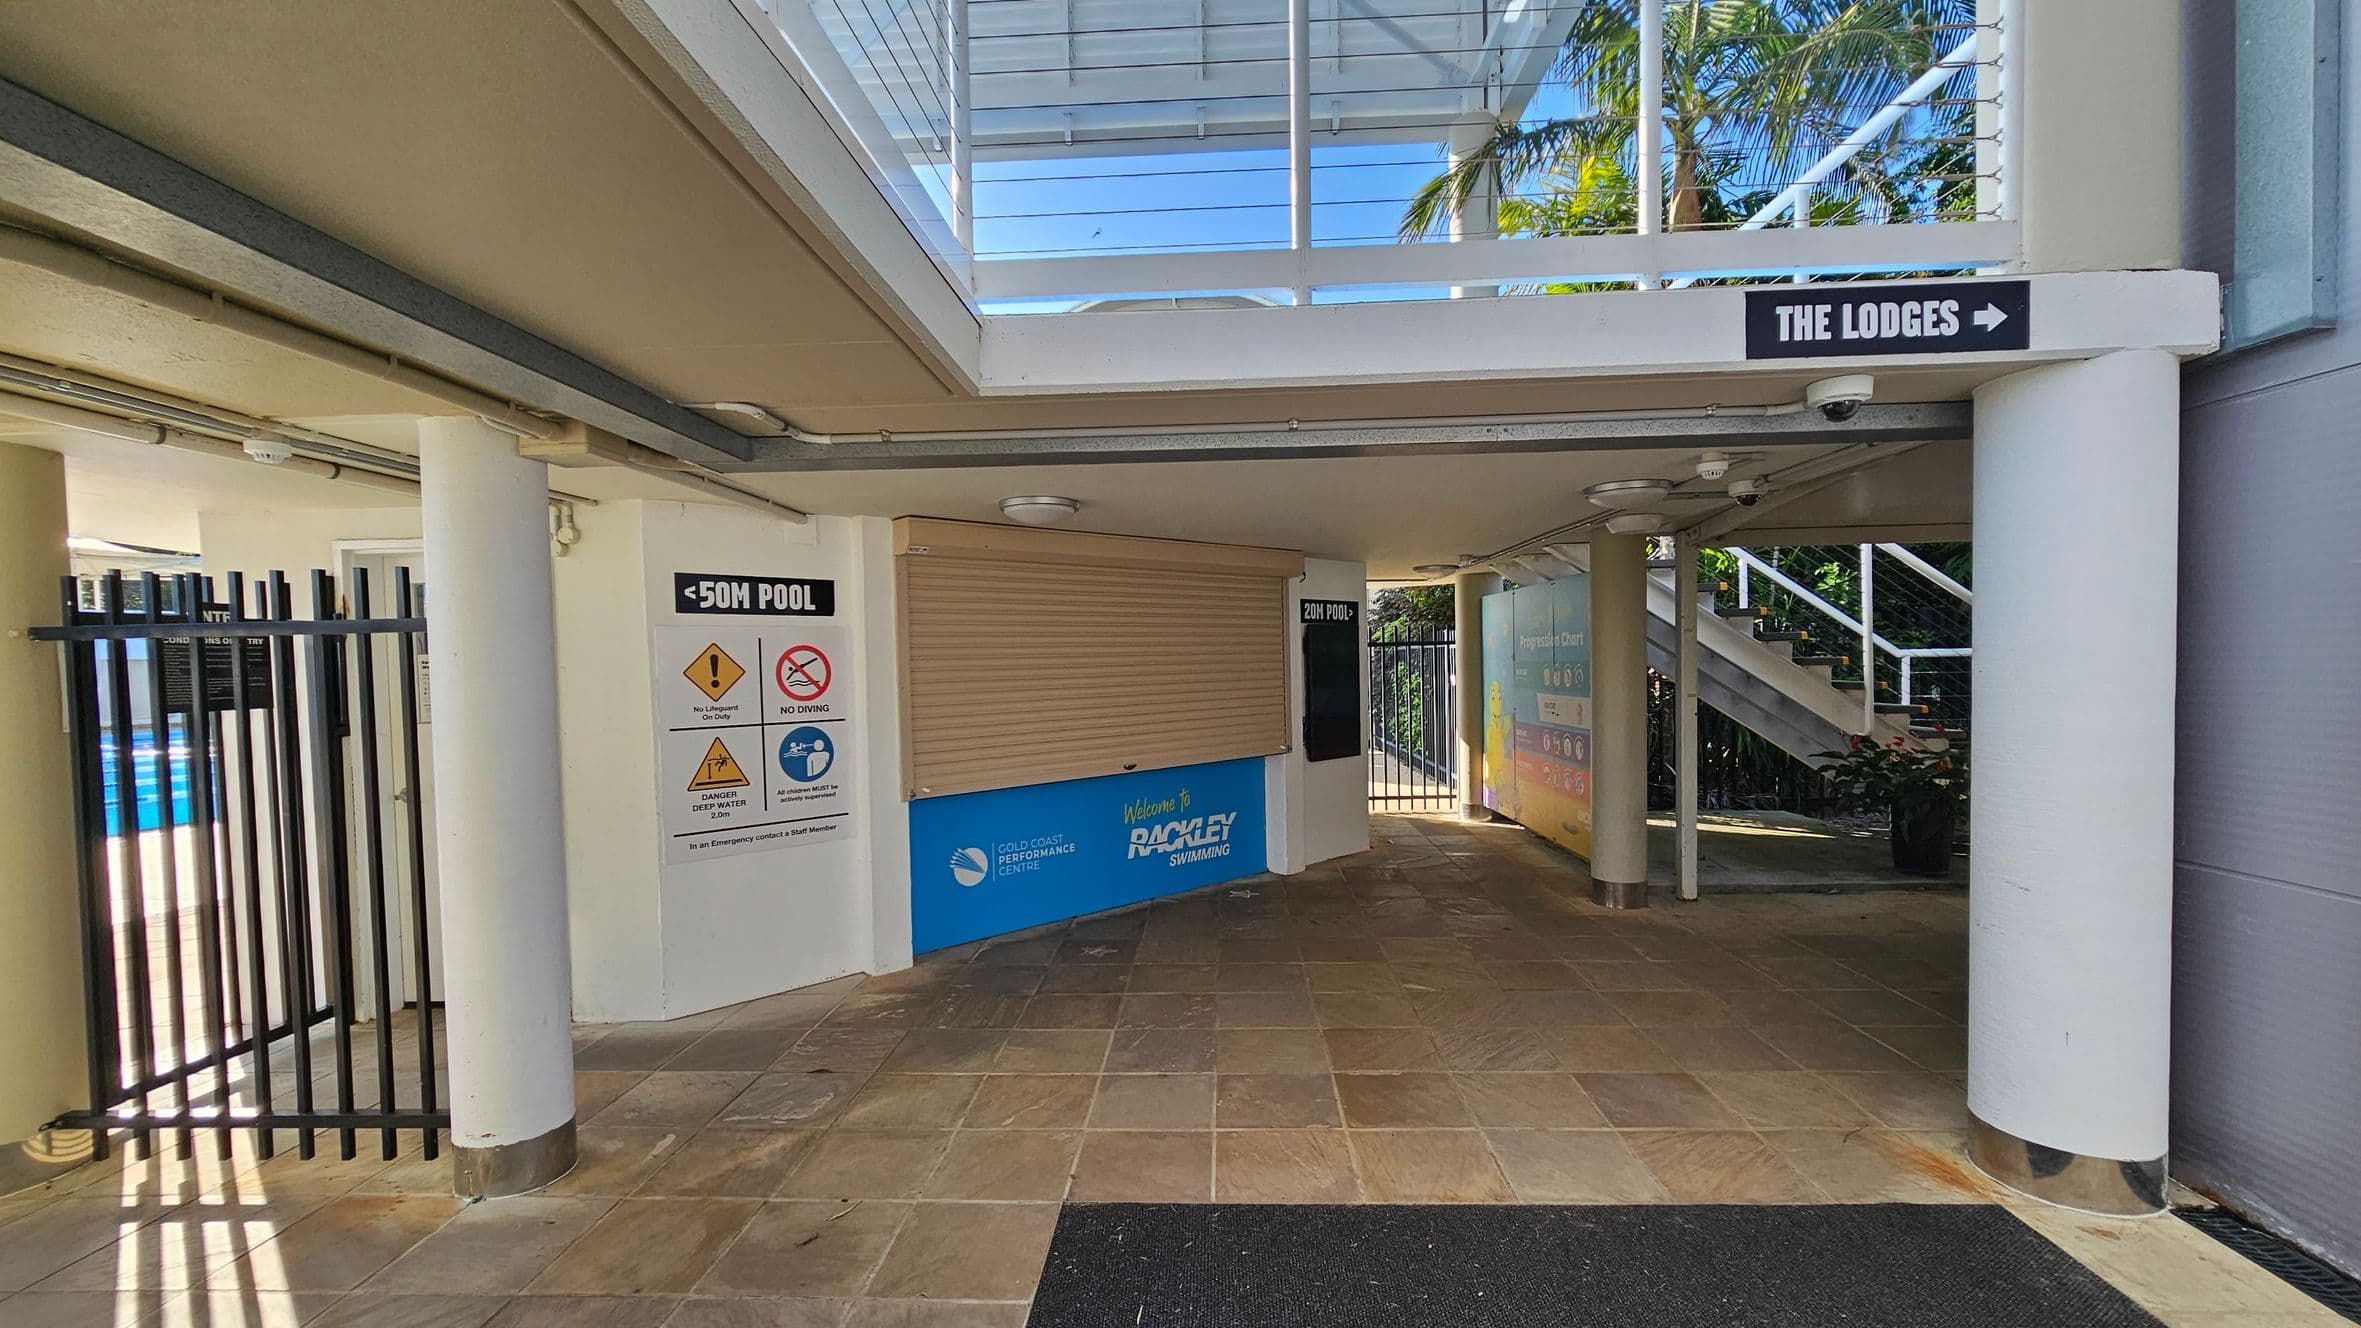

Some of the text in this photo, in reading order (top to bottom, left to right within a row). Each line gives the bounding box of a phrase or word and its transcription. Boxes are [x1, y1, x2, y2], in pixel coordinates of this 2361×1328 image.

[1776, 299, 1960, 342] THE LODGES
[758, 583, 817, 611] POOL
[1304, 603, 1324, 620] 20M
[1561, 631, 1584, 648] Chart
[714, 713, 731, 721] Duty
[780, 704, 830, 715] NO DIVING
[701, 791, 737, 801] DANGER
[786, 787, 811, 795] children
[812, 784, 830, 792] MUST
[692, 800, 747, 812] DEEP WATER
[1124, 788, 1191, 825] Welcome to
[711, 811, 731, 820] 2.0m
[689, 843, 698, 851] In
[711, 836, 754, 848] Emergency
[755, 831, 784, 841] contact
[790, 828, 808, 836] Staff
[809, 823, 837, 834] Member
[998, 833, 1064, 854] GOLD COAST
[1128, 811, 1238, 860] RACKLEY
[998, 843, 1077, 865] PERFORMANCE
[1169, 843, 1231, 867] SWIMMING
[998, 859, 1041, 877] CENTRE
